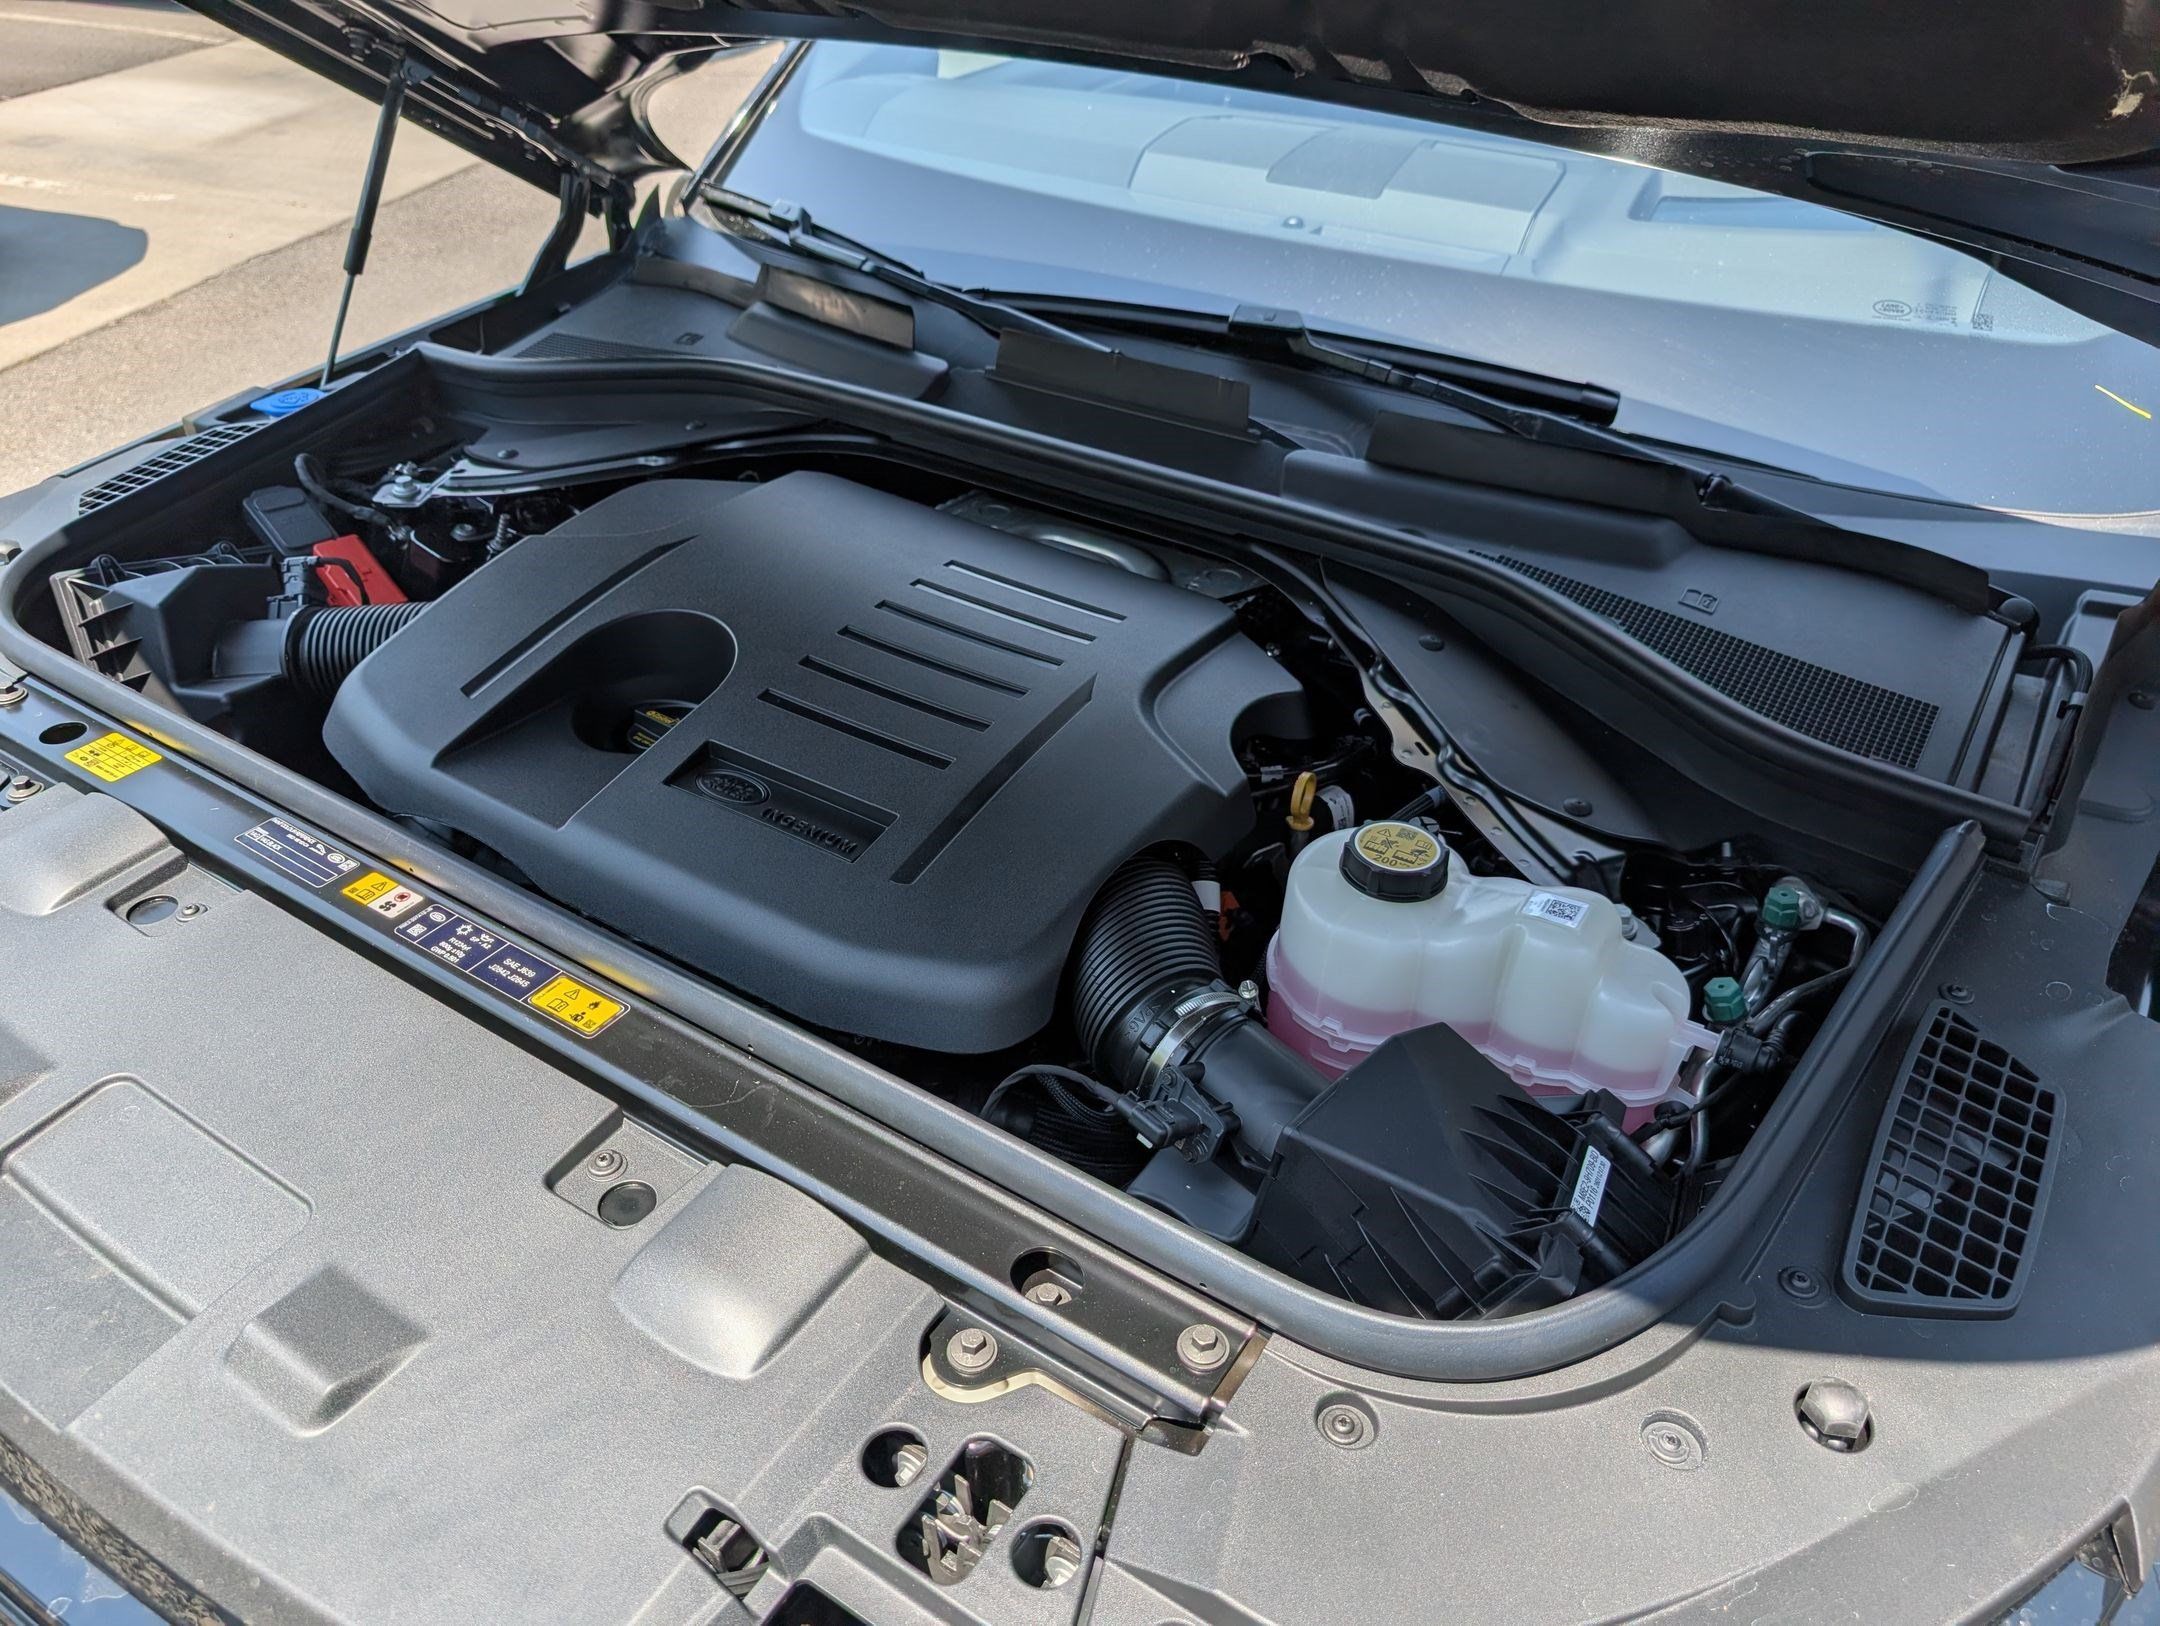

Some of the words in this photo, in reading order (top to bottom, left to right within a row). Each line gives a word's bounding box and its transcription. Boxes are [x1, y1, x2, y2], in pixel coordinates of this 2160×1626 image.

[760, 807, 857, 854] INGENIUM
[1374, 854, 1398, 867] 200
[488, 963, 511, 977] J2842
[507, 974, 531, 987] J2845
[503, 958, 521, 970] SAE
[517, 966, 536, 978] J639
